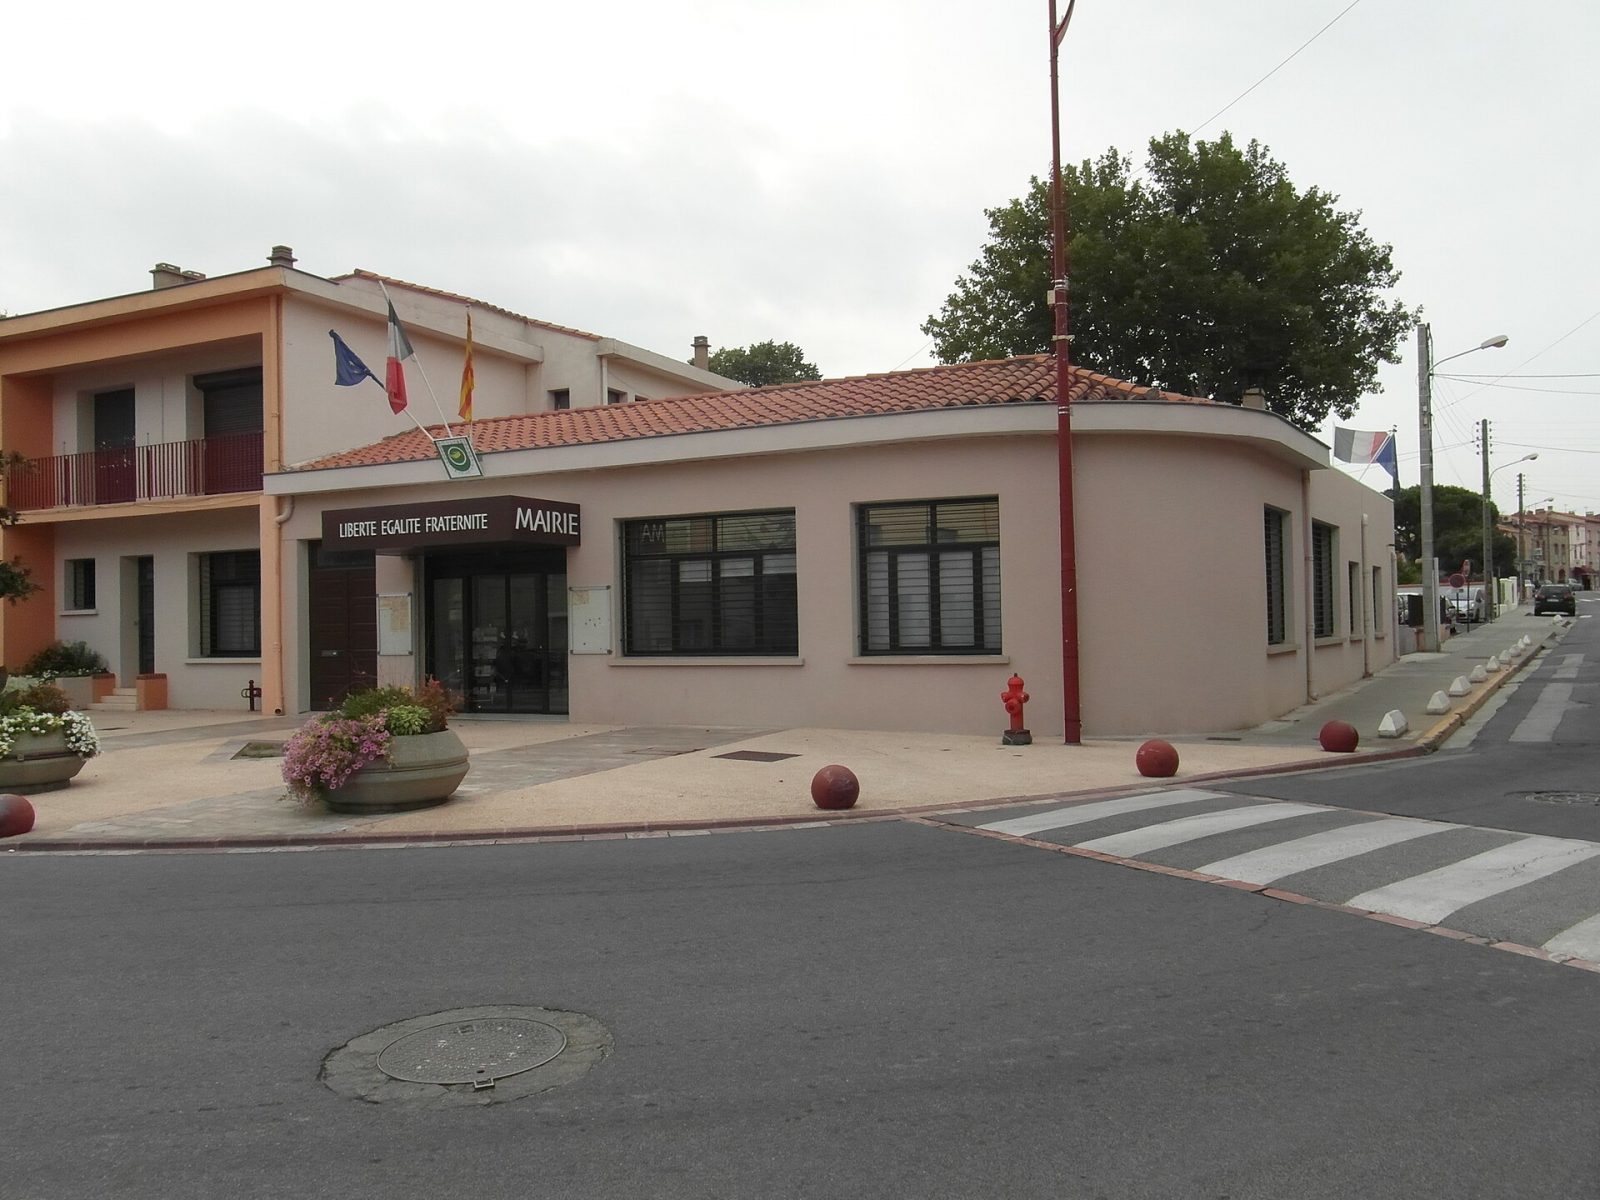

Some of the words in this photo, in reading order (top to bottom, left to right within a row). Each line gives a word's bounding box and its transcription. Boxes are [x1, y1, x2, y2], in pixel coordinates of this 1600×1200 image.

[339, 520, 377, 538] LIBERTE
[381, 517, 421, 536] EGALITE
[425, 513, 488, 532] FRATERNITE
[515, 507, 578, 536] MAIRIE
